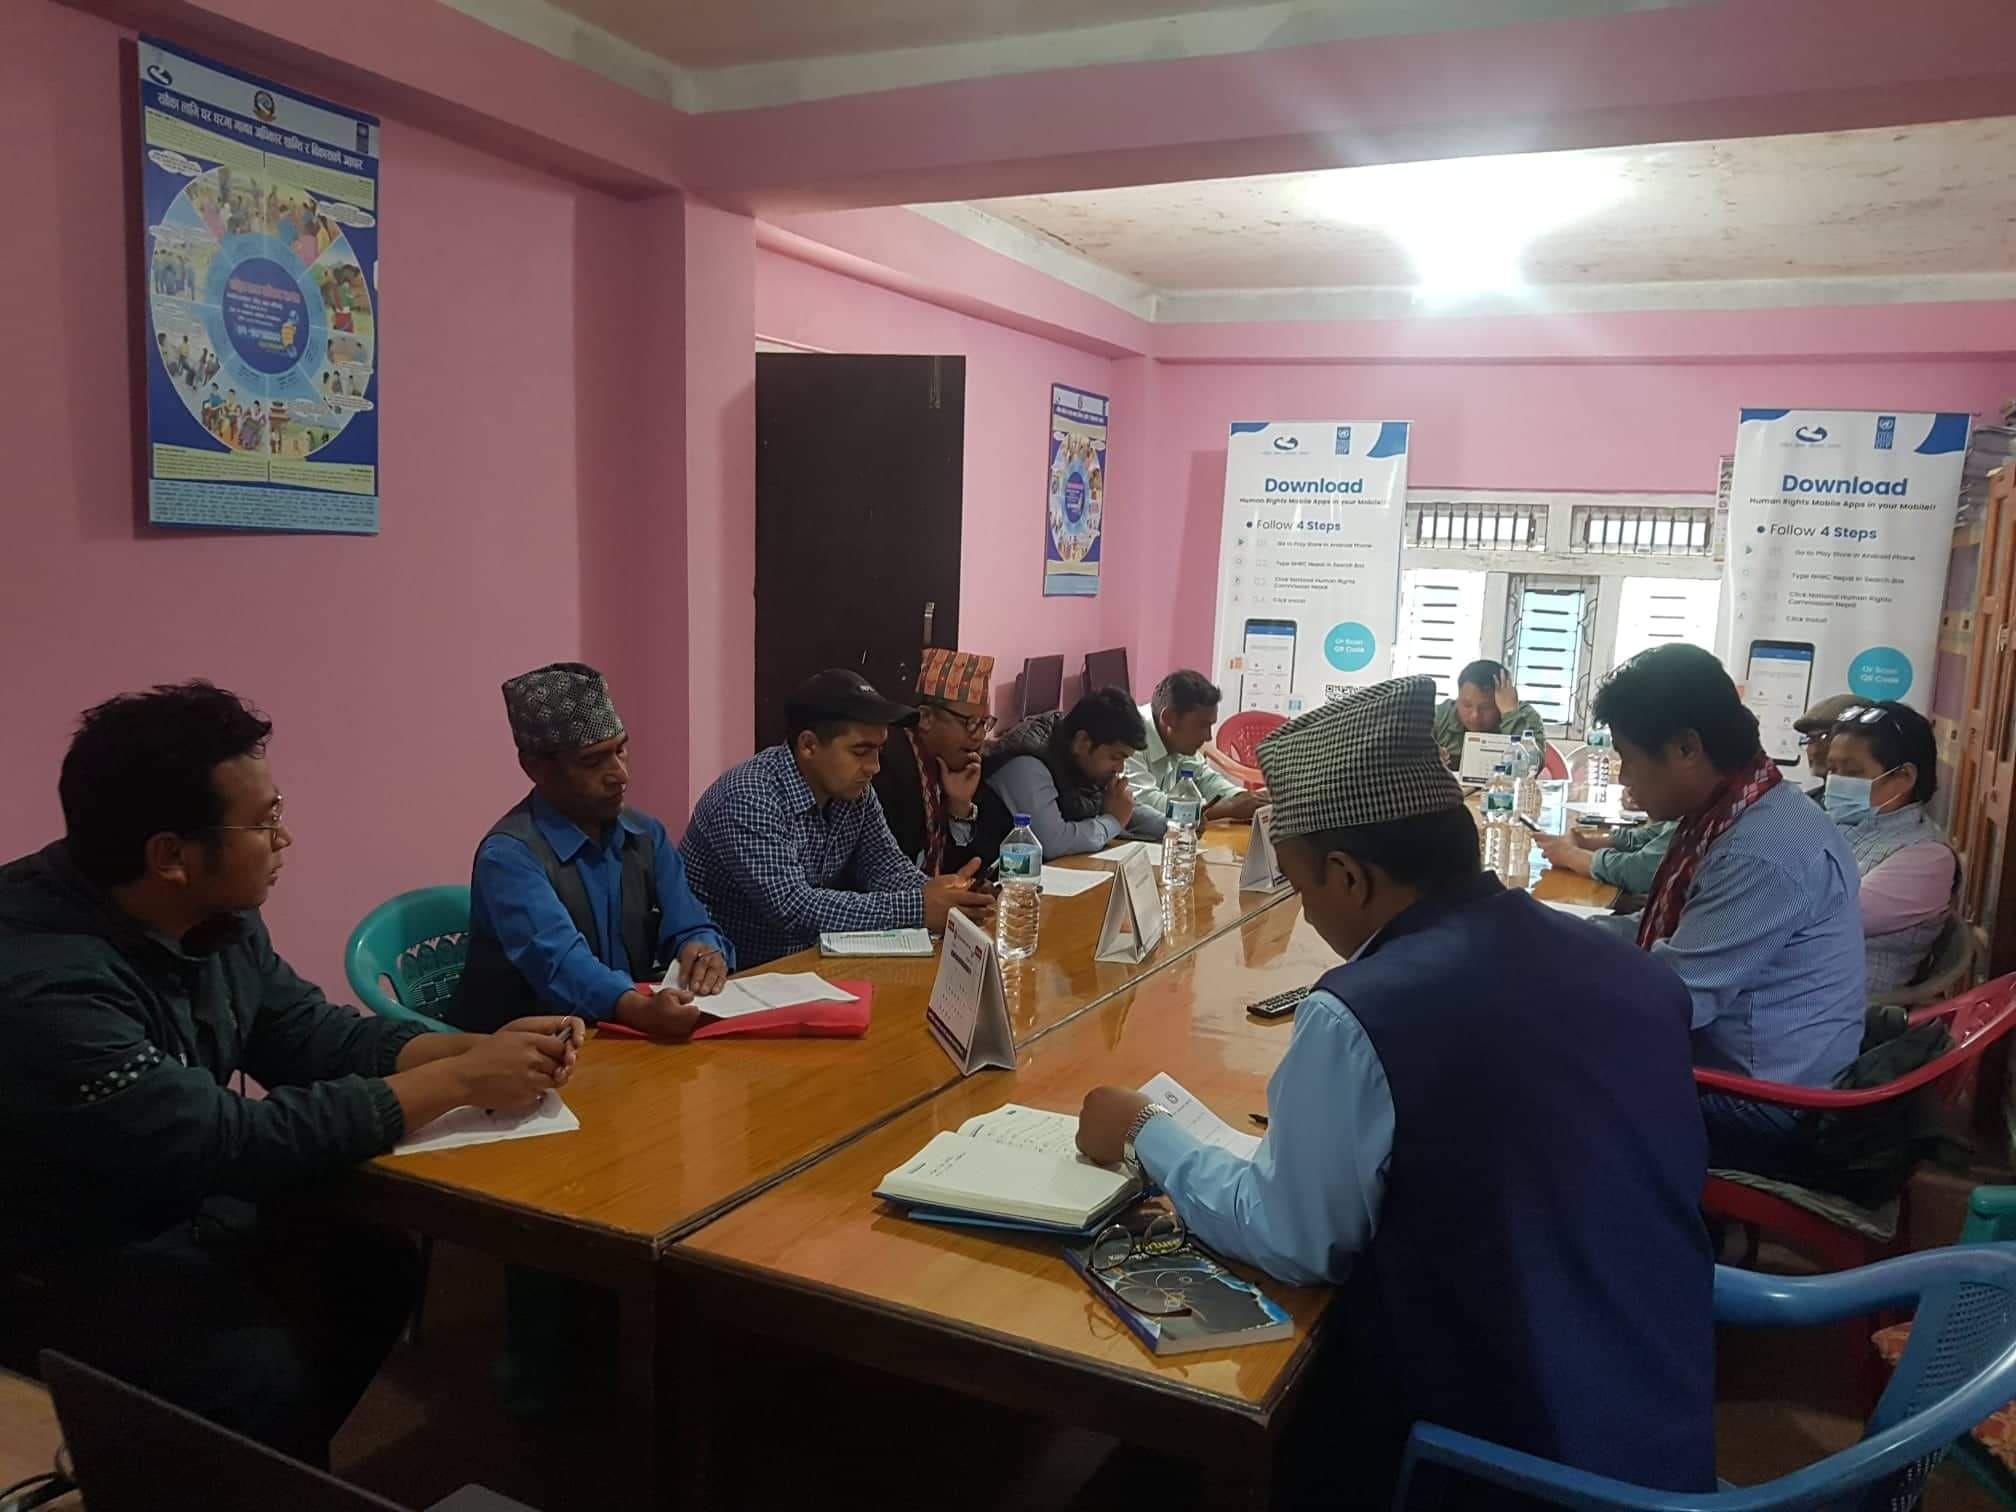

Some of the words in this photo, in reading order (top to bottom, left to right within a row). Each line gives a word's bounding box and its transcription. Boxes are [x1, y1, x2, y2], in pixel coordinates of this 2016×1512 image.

[201, 108, 213, 122] घर
[213, 111, 232, 129] घरमा
[1265, 478, 1363, 493] Download
[1782, 474, 1908, 496] Download
[1783, 498, 1809, 506] Rights
[1811, 499, 1841, 507] Mobile
[1843, 500, 1866, 509] Apps
[1878, 503, 1897, 511] your
[1257, 520, 1293, 530] Follow
[1297, 521, 1304, 529] 4
[1307, 521, 1341, 533] Steps
[1770, 524, 1816, 537] Follow
[1820, 526, 1830, 536] 4
[1834, 527, 1877, 542] Steps
[1816, 550, 1831, 559] Play
[1862, 552, 1891, 560] Android
